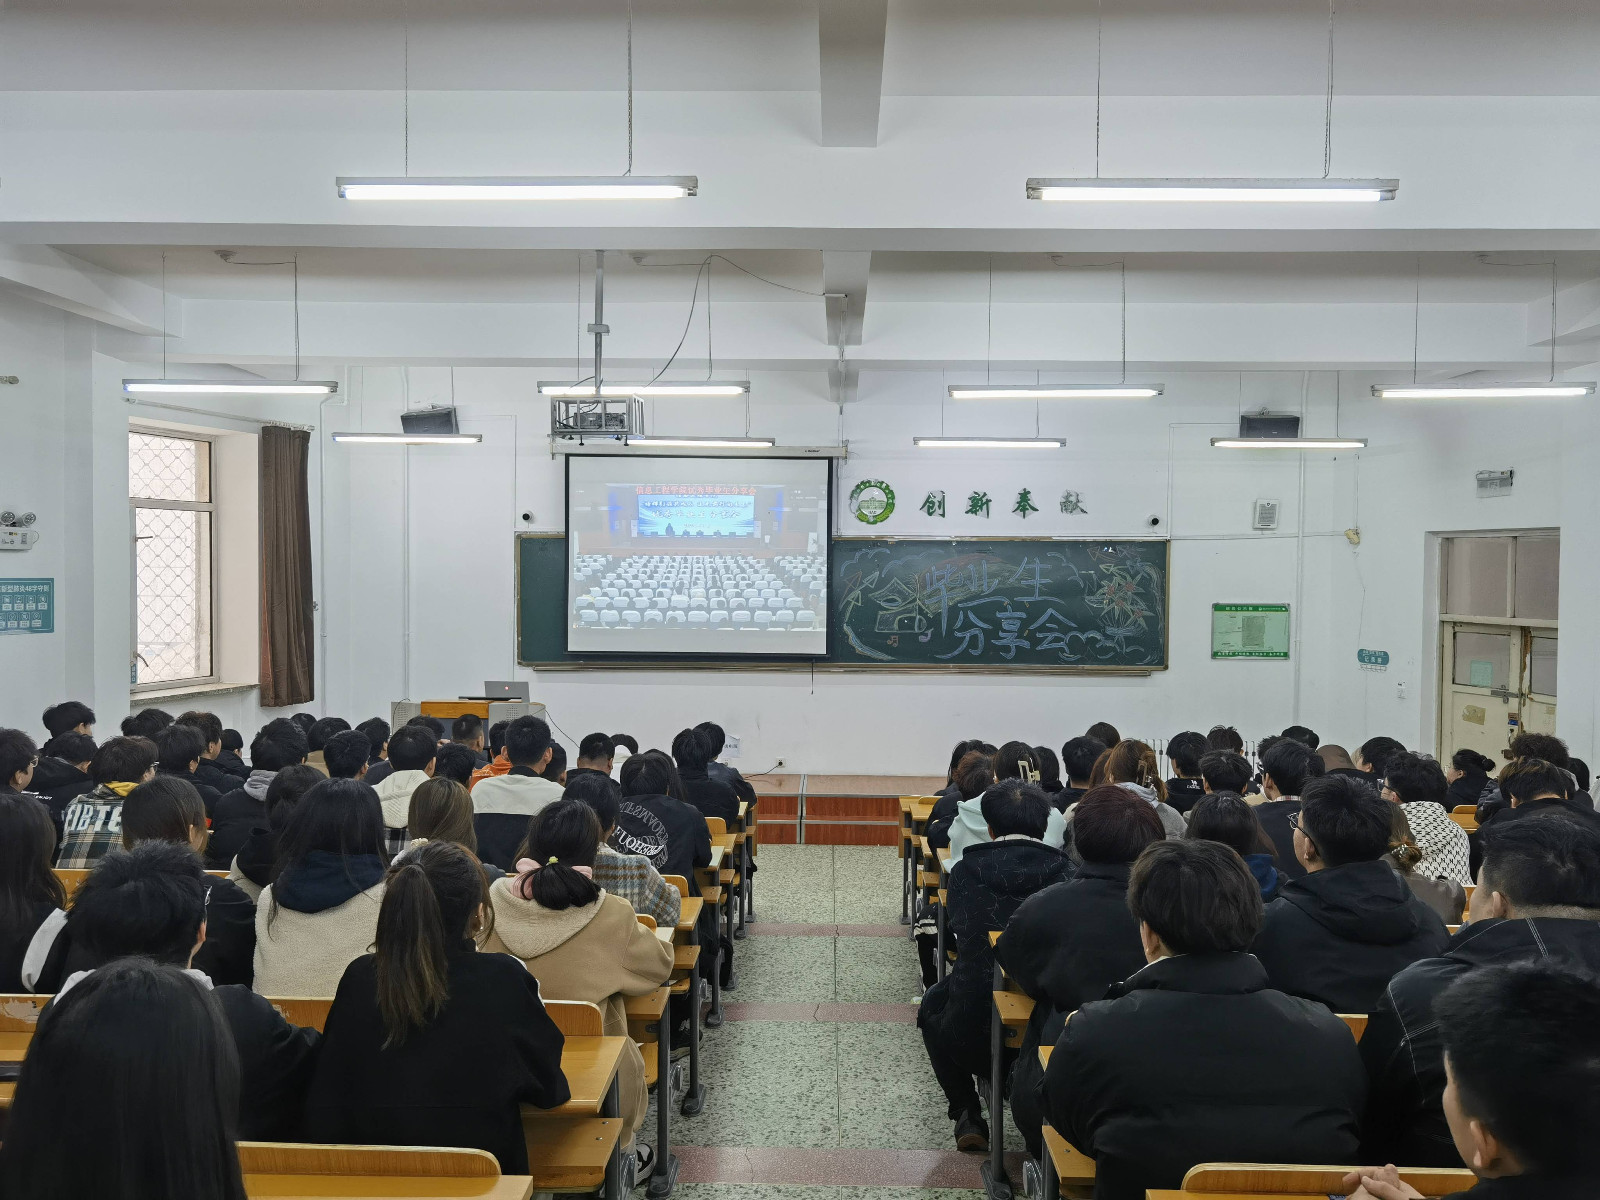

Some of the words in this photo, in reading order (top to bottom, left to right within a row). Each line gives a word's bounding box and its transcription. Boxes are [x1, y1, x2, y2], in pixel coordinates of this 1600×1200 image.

[925, 556, 1067, 639] 毕业生
[933, 605, 1080, 659] 分享会
